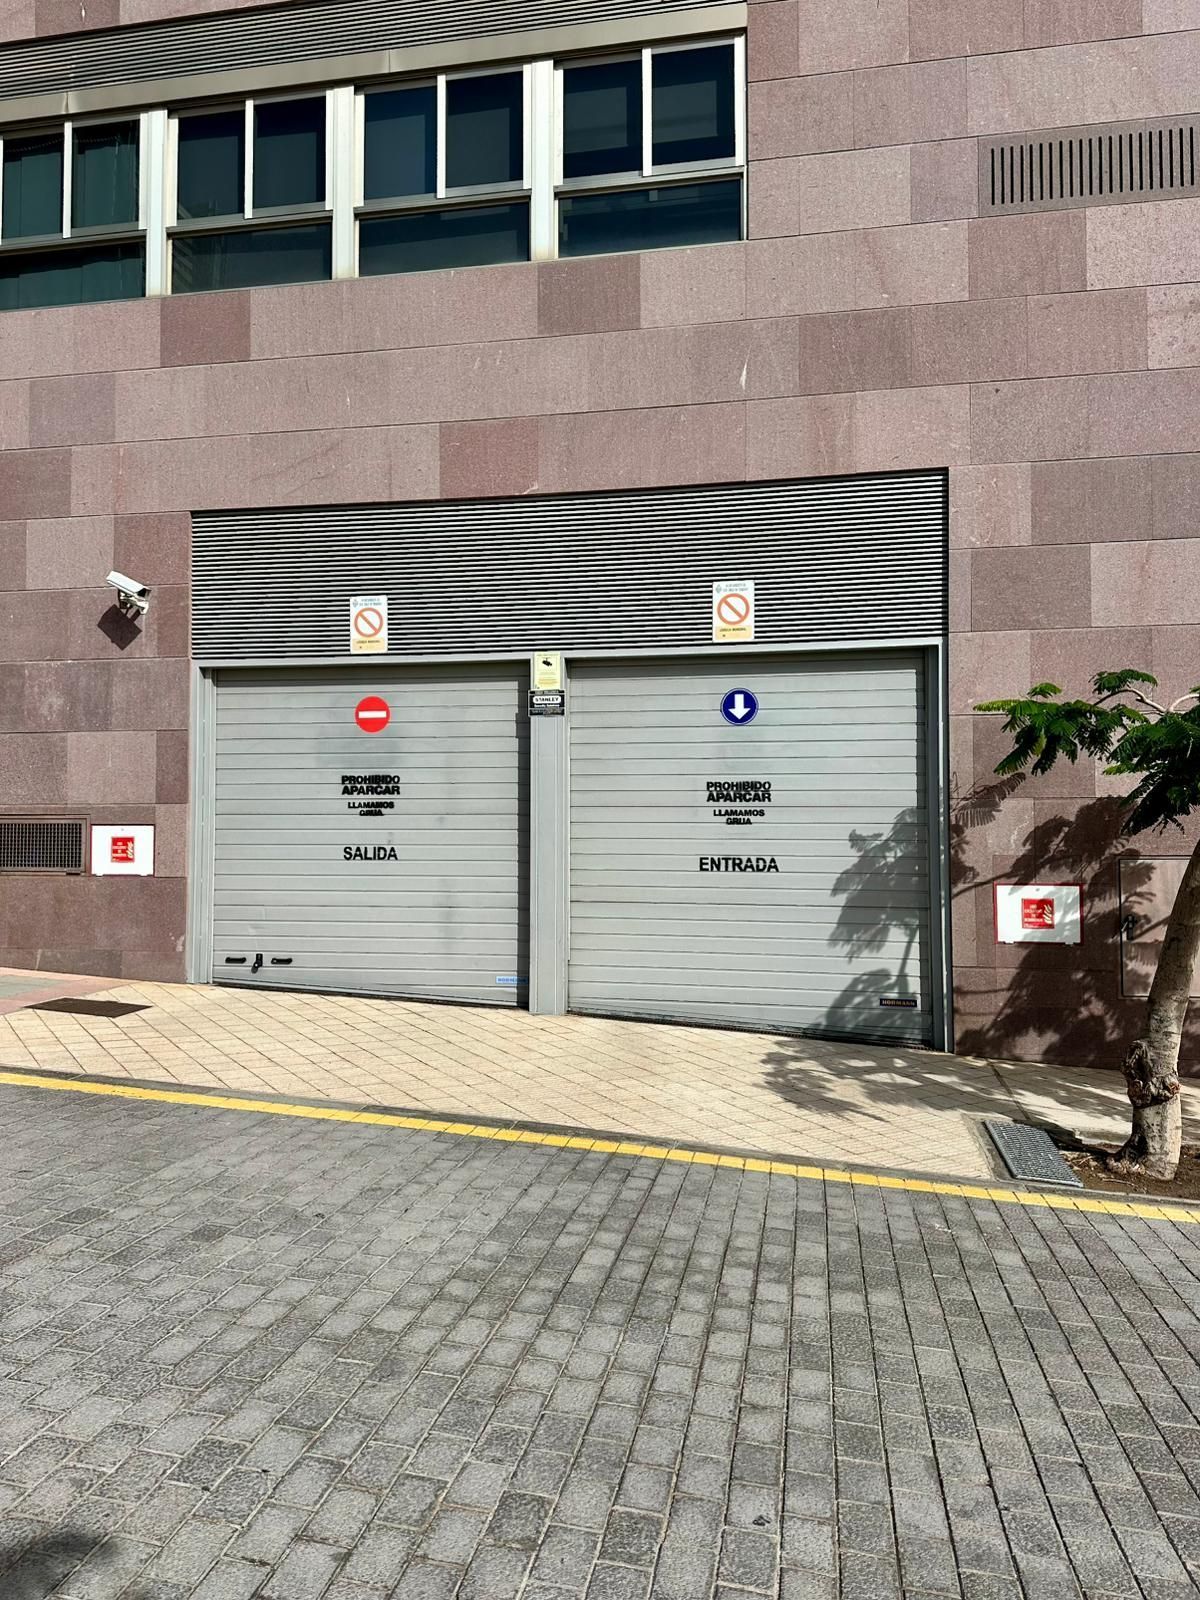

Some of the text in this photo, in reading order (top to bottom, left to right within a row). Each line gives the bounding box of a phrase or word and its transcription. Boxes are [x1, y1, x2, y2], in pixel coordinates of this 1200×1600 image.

[341, 775, 400, 785] PROHIBIDO
[341, 785, 400, 795] APARCAR
[706, 781, 771, 791] PROHIBIDO
[706, 792, 771, 802] APARCAR
[347, 801, 395, 809] LLAMAMOS
[713, 809, 765, 817] LLAMAMOS
[343, 846, 398, 861] SALIDA
[699, 857, 779, 873] ENTRADA
